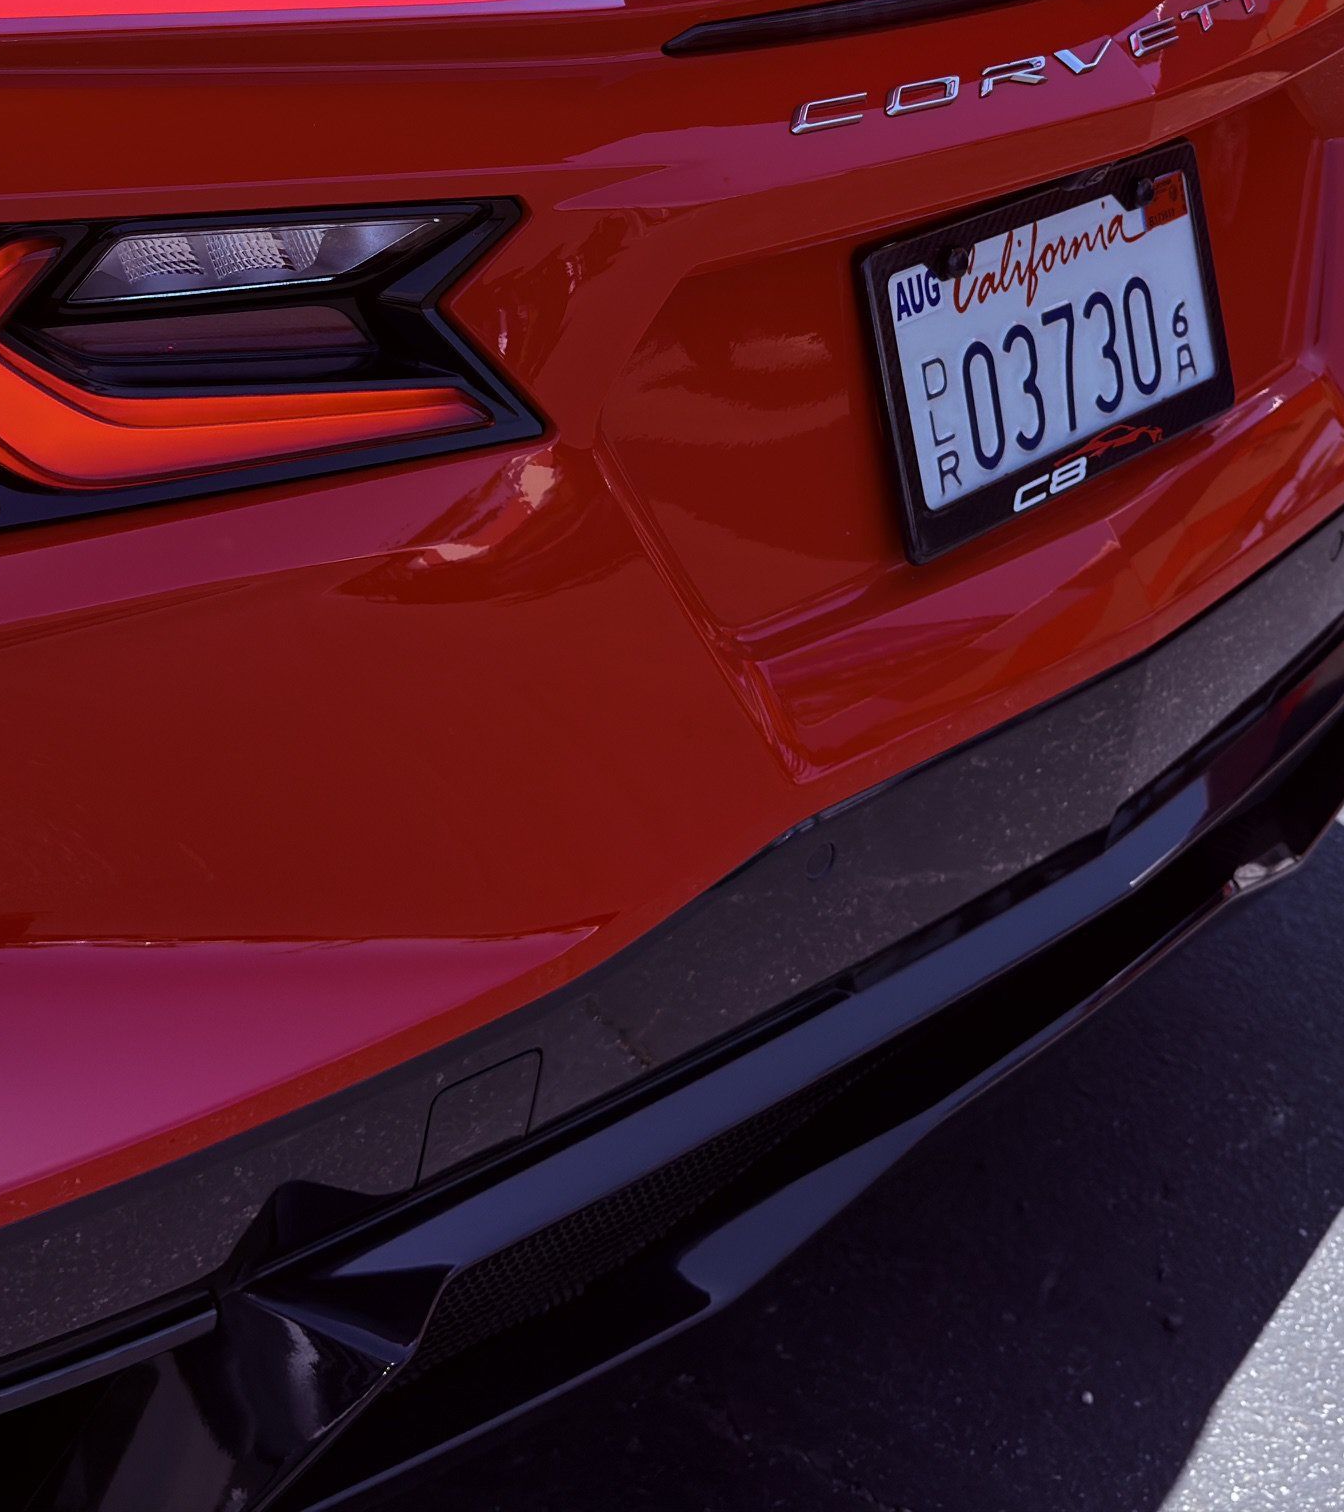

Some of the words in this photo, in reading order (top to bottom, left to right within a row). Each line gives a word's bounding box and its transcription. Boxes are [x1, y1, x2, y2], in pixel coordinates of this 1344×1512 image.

[896, 270, 941, 322] AUG
[953, 201, 1147, 314] California
[962, 276, 1163, 471] 03730
[1013, 456, 1088, 512] C8
